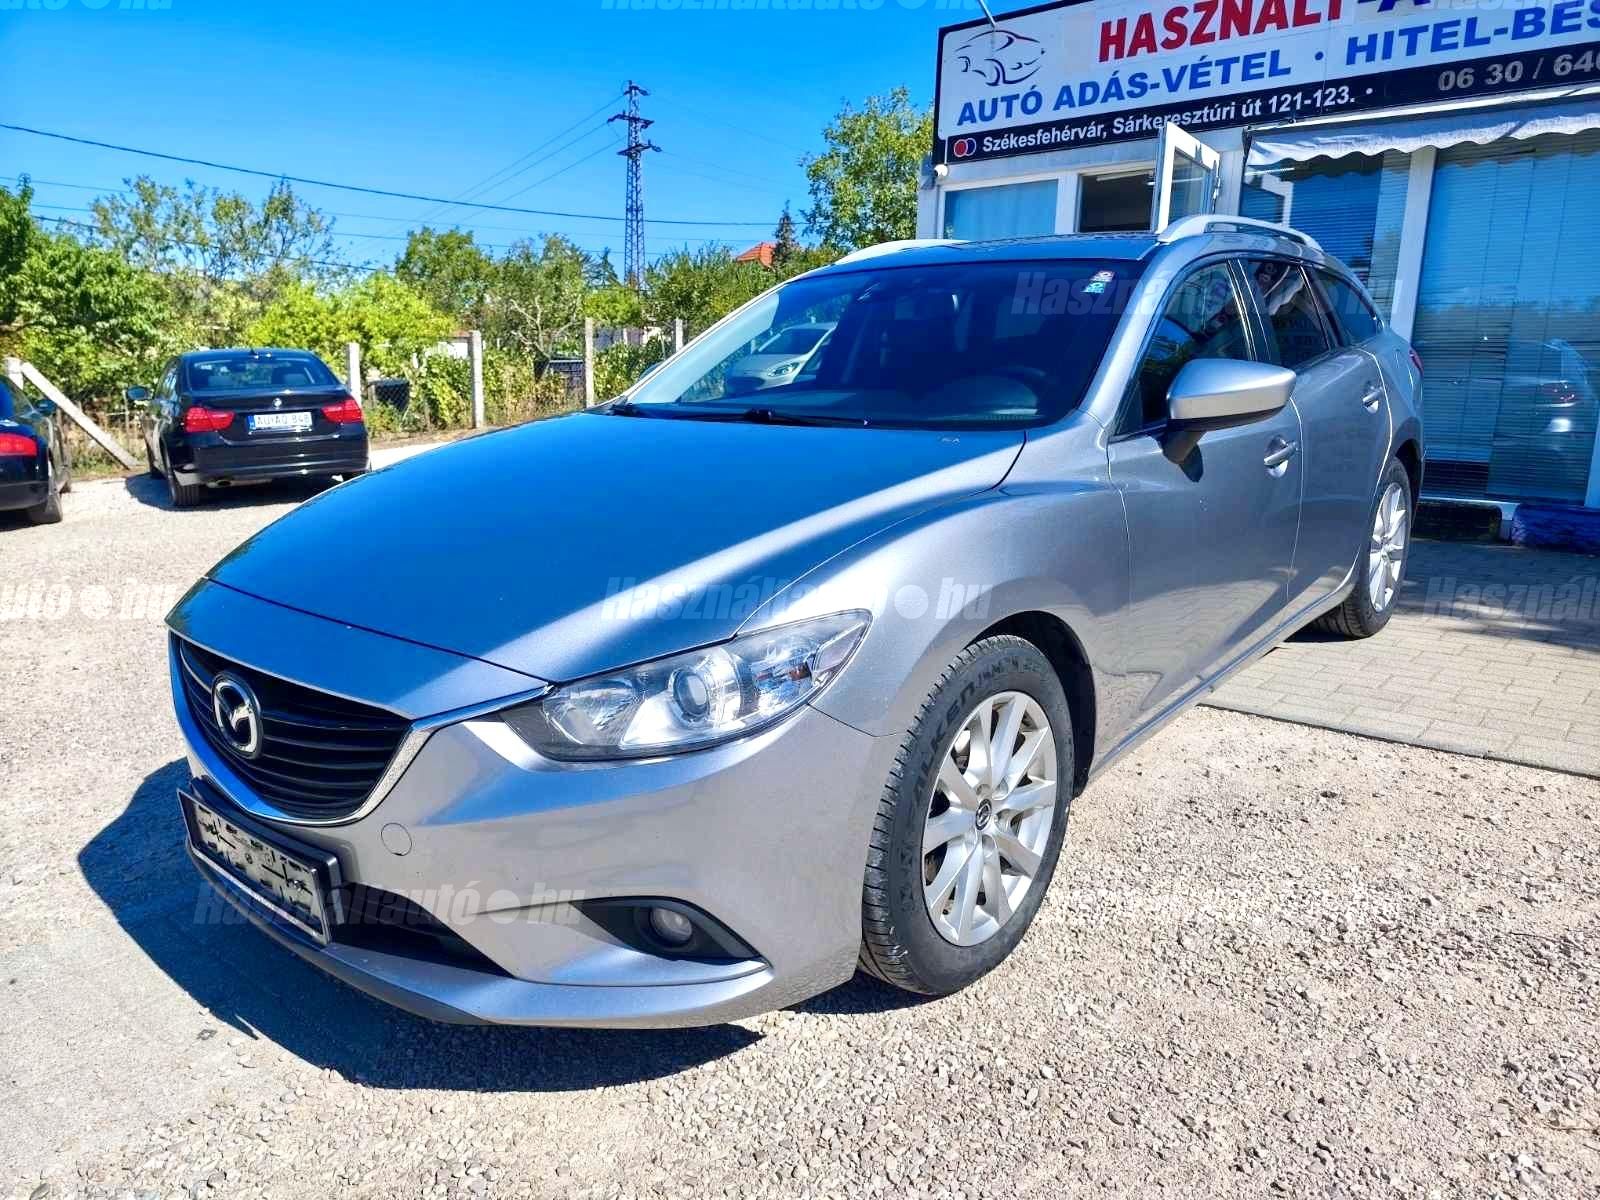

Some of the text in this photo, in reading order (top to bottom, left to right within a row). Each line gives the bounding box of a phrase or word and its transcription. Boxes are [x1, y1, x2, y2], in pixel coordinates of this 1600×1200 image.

[957, 84, 1043, 126] AUTÓ
[1053, 50, 1292, 112] ADÁS-VÉTEL
[1438, 67, 1475, 91] 06
[1485, 60, 1524, 85] 30
[1553, 50, 1600, 76] 64
[983, 86, 1356, 153] Székesfehérvár, Sárkeresztúri út 121-123.
